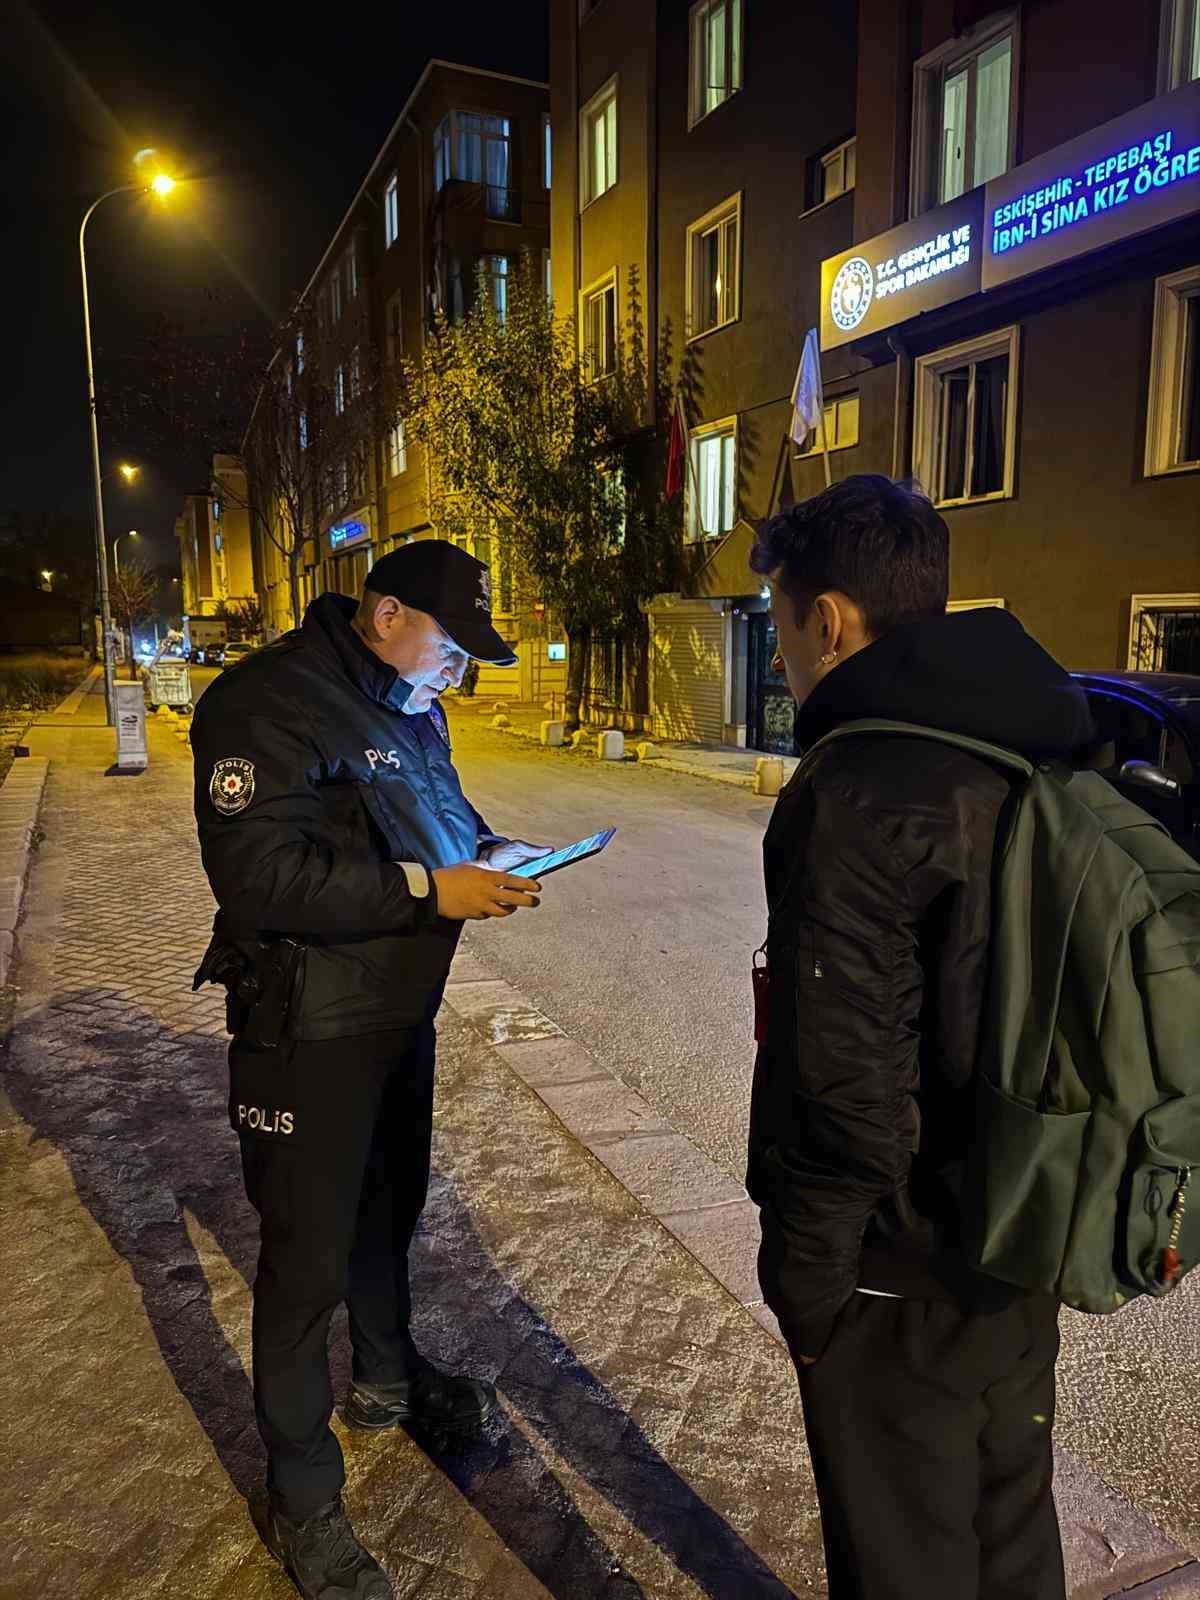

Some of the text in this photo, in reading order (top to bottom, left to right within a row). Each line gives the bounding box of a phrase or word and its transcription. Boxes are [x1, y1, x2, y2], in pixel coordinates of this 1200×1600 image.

[994, 177, 1073, 227] ESKİŞEHİR
[1084, 131, 1172, 187] TEPEBAŞI
[898, 234, 950, 270] GENÇLİK
[952, 224, 970, 245] VE
[993, 213, 1037, 254] İBN-İ
[1041, 202, 1088, 234] SİNA
[1094, 178, 1129, 212] KIZ
[875, 245, 970, 299] SPOR BAKANLIĞI
